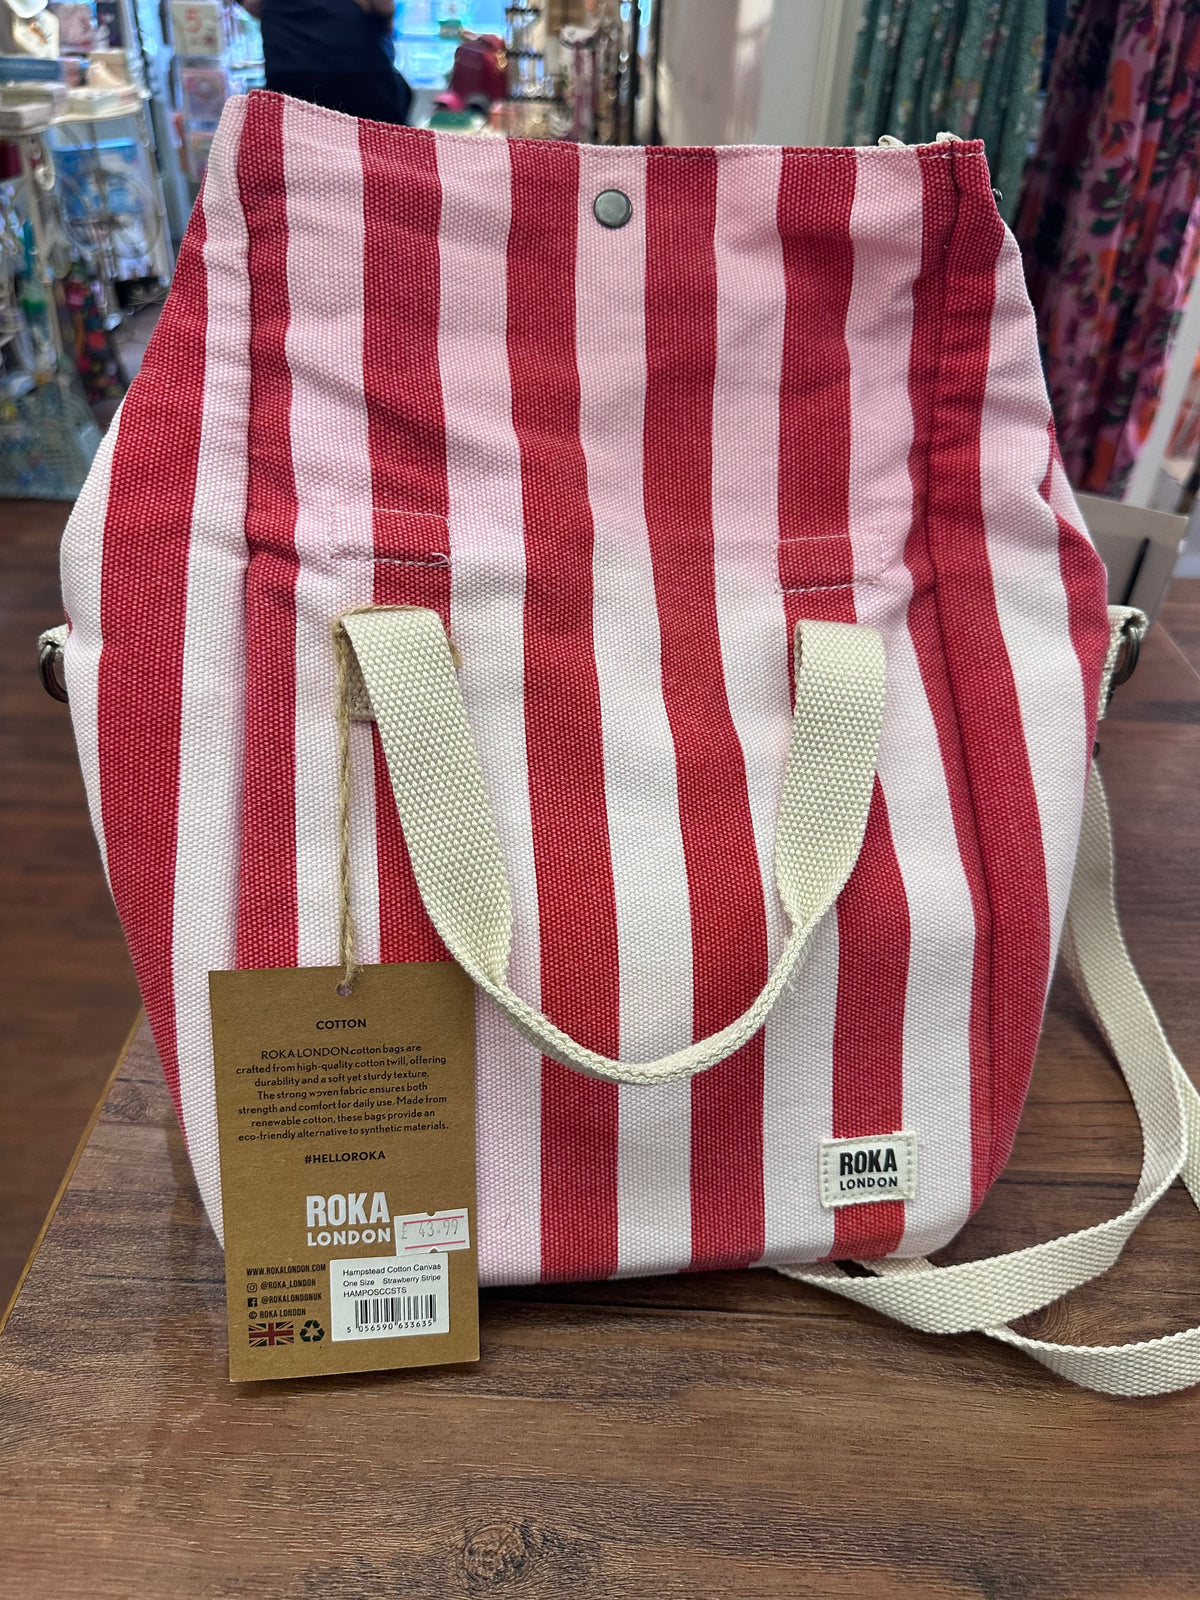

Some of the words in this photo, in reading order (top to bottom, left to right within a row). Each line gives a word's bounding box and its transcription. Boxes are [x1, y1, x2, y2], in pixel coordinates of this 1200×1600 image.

[316, 1018, 367, 1030] COTTON
[261, 1048, 296, 1060] ROKA
[297, 1046, 349, 1058] LONDON
[350, 1046, 381, 1055] cotton
[383, 1044, 405, 1054] bags
[236, 1063, 271, 1075] crafted
[272, 1063, 296, 1073] from
[297, 1060, 353, 1073] high-quality
[355, 1059, 385, 1068] cotton
[387, 1056, 409, 1066] twill,
[410, 1055, 447, 1065] offering
[254, 1076, 300, 1087] durability
[301, 1074, 319, 1084] and
[328, 1072, 346, 1082] soft
[347, 1074, 362, 1084] yet
[363, 1070, 392, 1081] sturdy
[393, 1070, 430, 1079] texture.
[257, 1090, 276, 1100] The
[276, 1090, 307, 1099] strong
[308, 1089, 339, 1097] woven
[340, 1086, 368, 1096] fabric
[369, 1085, 405, 1093] ensures
[406, 1081, 428, 1091] both
[238, 1103, 278, 1115] strength
[279, 1102, 297, 1112] and
[298, 1100, 336, 1111] comfort
[338, 1100, 351, 1109] for
[352, 1098, 375, 1109] daily
[396, 1095, 424, 1105] Made
[425, 1094, 447, 1104] from
[251, 1116, 301, 1127] renewable
[302, 1115, 336, 1124] cotton,
[337, 1113, 363, 1122] these
[364, 1111, 386, 1122] bags
[387, 1109, 423, 1121] provide
[238, 1129, 296, 1141] eco-friendly
[297, 1127, 348, 1138] alternative
[349, 1127, 359, 1135] to
[360, 1124, 402, 1135] synthetic
[403, 1120, 449, 1132] materials.
[304, 1150, 386, 1164] #HELLOROKA
[840, 1147, 898, 1176] ROKA
[840, 1176, 898, 1191] LONDON
[306, 1191, 391, 1227] ROKA
[307, 1227, 391, 1247] LONDON
[246, 1263, 327, 1276] WWW.ROKALONDON.COM
[342, 1266, 385, 1277] Hampstead
[387, 1265, 412, 1273] Cotton
[413, 1263, 441, 1271] Canvas
[382, 1275, 420, 1284] Strawberry
[421, 1274, 441, 1282] Stripe
[343, 1286, 408, 1298] HAMPOSCCSTS
[259, 1309, 278, 1319] ROKA
[279, 1307, 307, 1318] LONDON
[346, 1326, 352, 1334] 5
[358, 1322, 394, 1333] 056590
[398, 1319, 433, 1329] 633635
